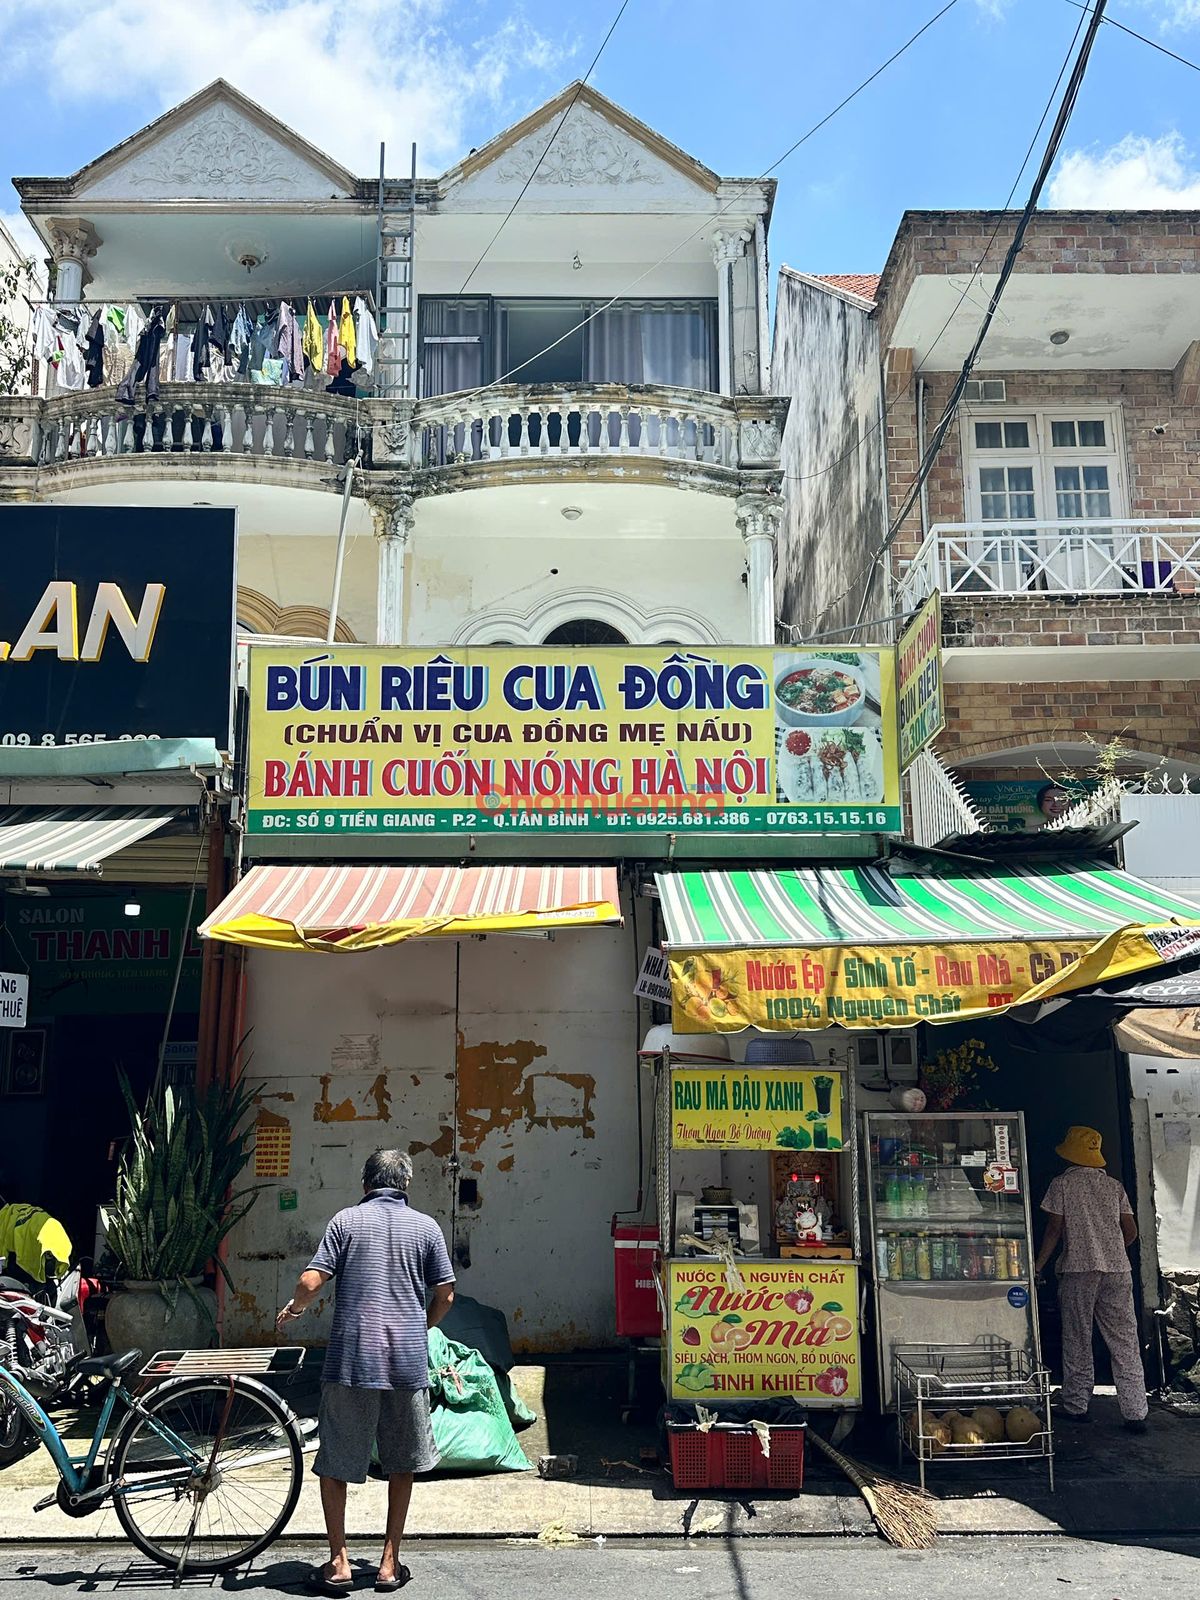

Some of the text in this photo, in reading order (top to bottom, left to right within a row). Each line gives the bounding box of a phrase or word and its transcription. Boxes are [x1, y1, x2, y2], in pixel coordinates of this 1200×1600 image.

[0, 581, 166, 662] AN
[266, 653, 767, 711] BÚN RIÊU CUA ĐỒNG
[284, 716, 751, 747] (CHUẨN VỊ CUA ĐỒNG MẸ NẤU)
[264, 750, 768, 803] BÁNH CUỐN NÓNG HÀ NỘI
[262, 814, 290, 828] ĐC:
[296, 810, 320, 828] SỐ
[323, 815, 335, 828] 9
[340, 810, 378, 828] TIỀN
[383, 814, 435, 828] GIANG
[452, 814, 477, 827] P.2
[493, 810, 544, 827] Q.TÂN
[548, 809, 589, 826] BÌNH
[606, 813, 631, 826] ĐT:
[636, 812, 750, 826] 0925.681.386
[766, 812, 886, 825] 0763.15.15.16
[18, 907, 84, 924] SALON
[30, 929, 170, 961] THANH
[745, 959, 796, 991] Nước
[801, 953, 825, 995] Ép
[844, 955, 888, 989] Sinh
[894, 951, 917, 987] Tố
[935, 955, 973, 986] Rau
[977, 953, 1012, 986] Má
[1029, 953, 1056, 984] Cà
[0, 997, 23, 1018] HUÊ
[766, 996, 820, 1020] 100%
[828, 995, 908, 1021] Nguyên
[914, 992, 962, 1016] Chất
[674, 1074, 803, 1117] RAU MÁ ĐẬU XANH
[676, 1269, 716, 1282] NƯỚC
[750, 1269, 804, 1283] NGUYÊN
[808, 1268, 845, 1283] CHẤT
[686, 1285, 784, 1313] Nước
[745, 1320, 831, 1349] Mía
[675, 1350, 697, 1364] SIÊU
[733, 1352, 763, 1364] THƠM
[766, 1352, 798, 1365] NGON,
[801, 1348, 816, 1364] BỔ
[710, 1367, 816, 1391] TINH KHIẾT
